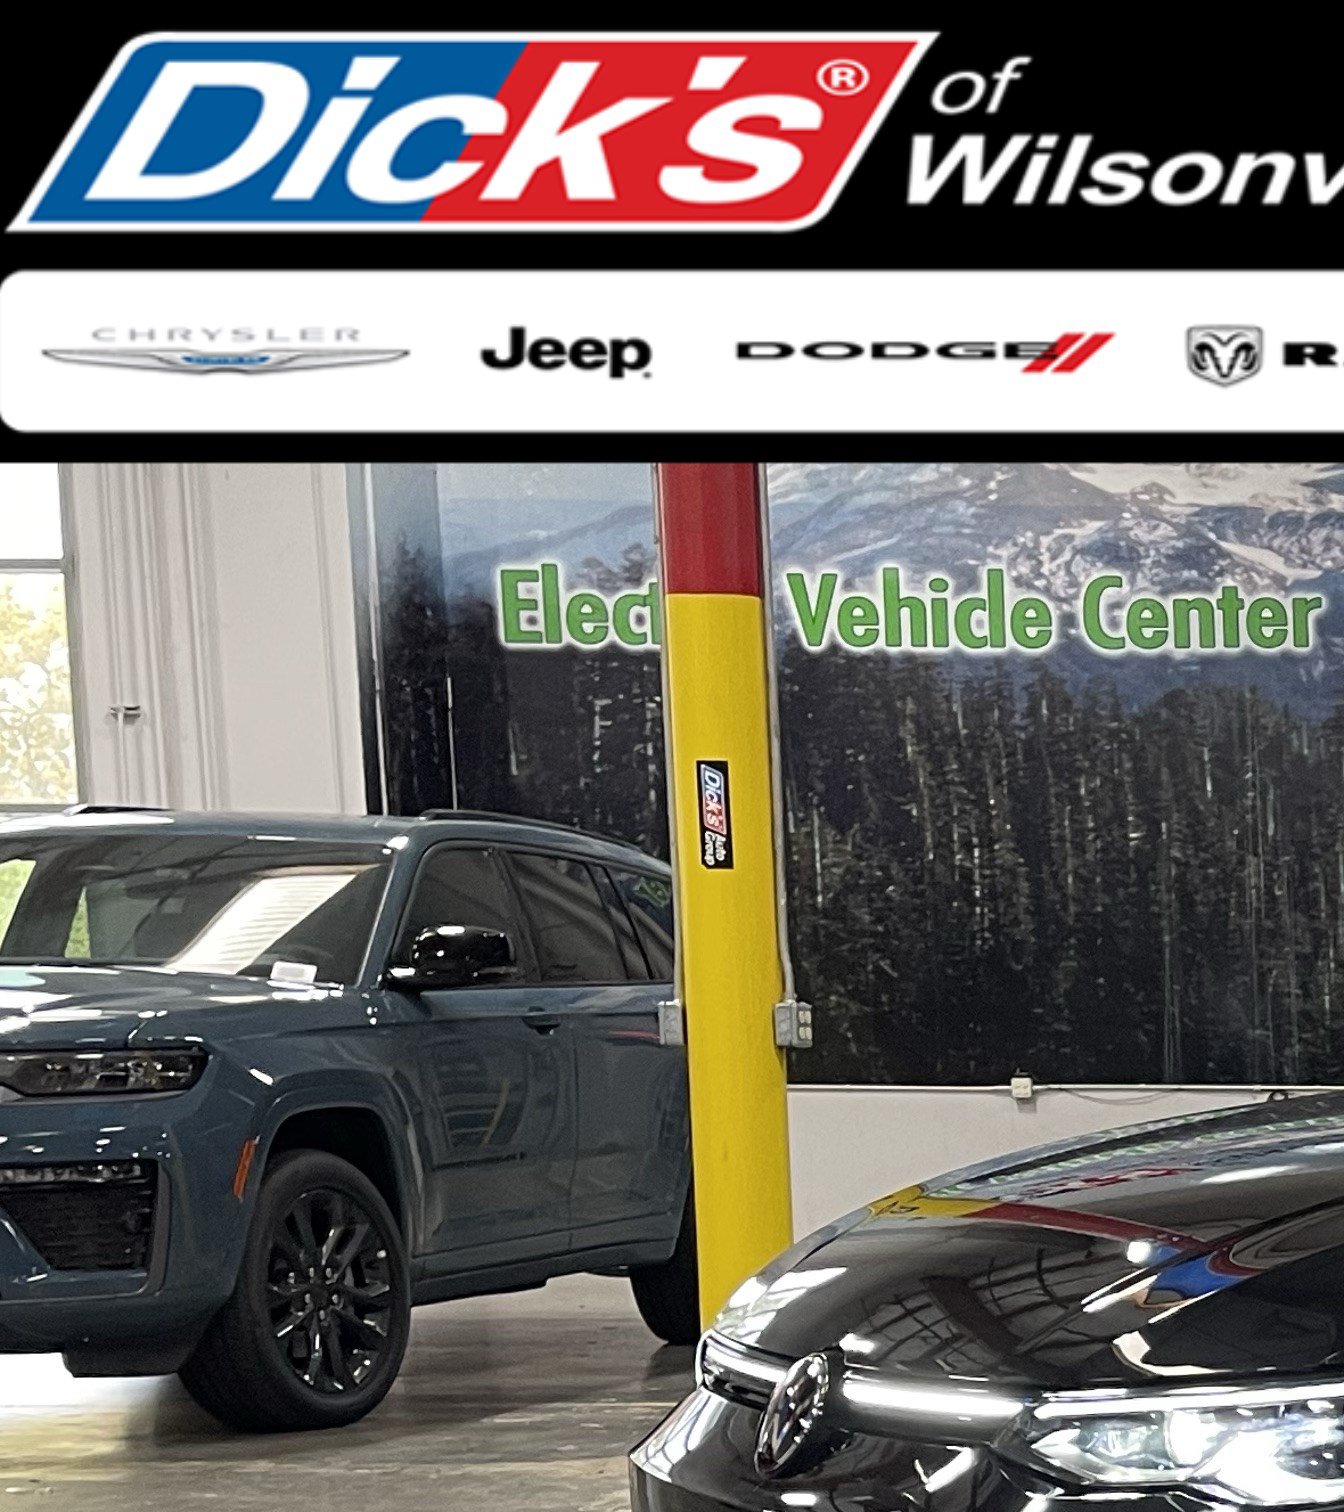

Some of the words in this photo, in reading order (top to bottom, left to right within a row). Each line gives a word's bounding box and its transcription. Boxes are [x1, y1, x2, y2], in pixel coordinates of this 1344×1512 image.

[500, 563, 661, 645] Elect
[786, 566, 1052, 648] Vehicle
[1084, 576, 1324, 648] Center
[704, 831, 715, 866] Group
[715, 833, 726, 861] Auto
